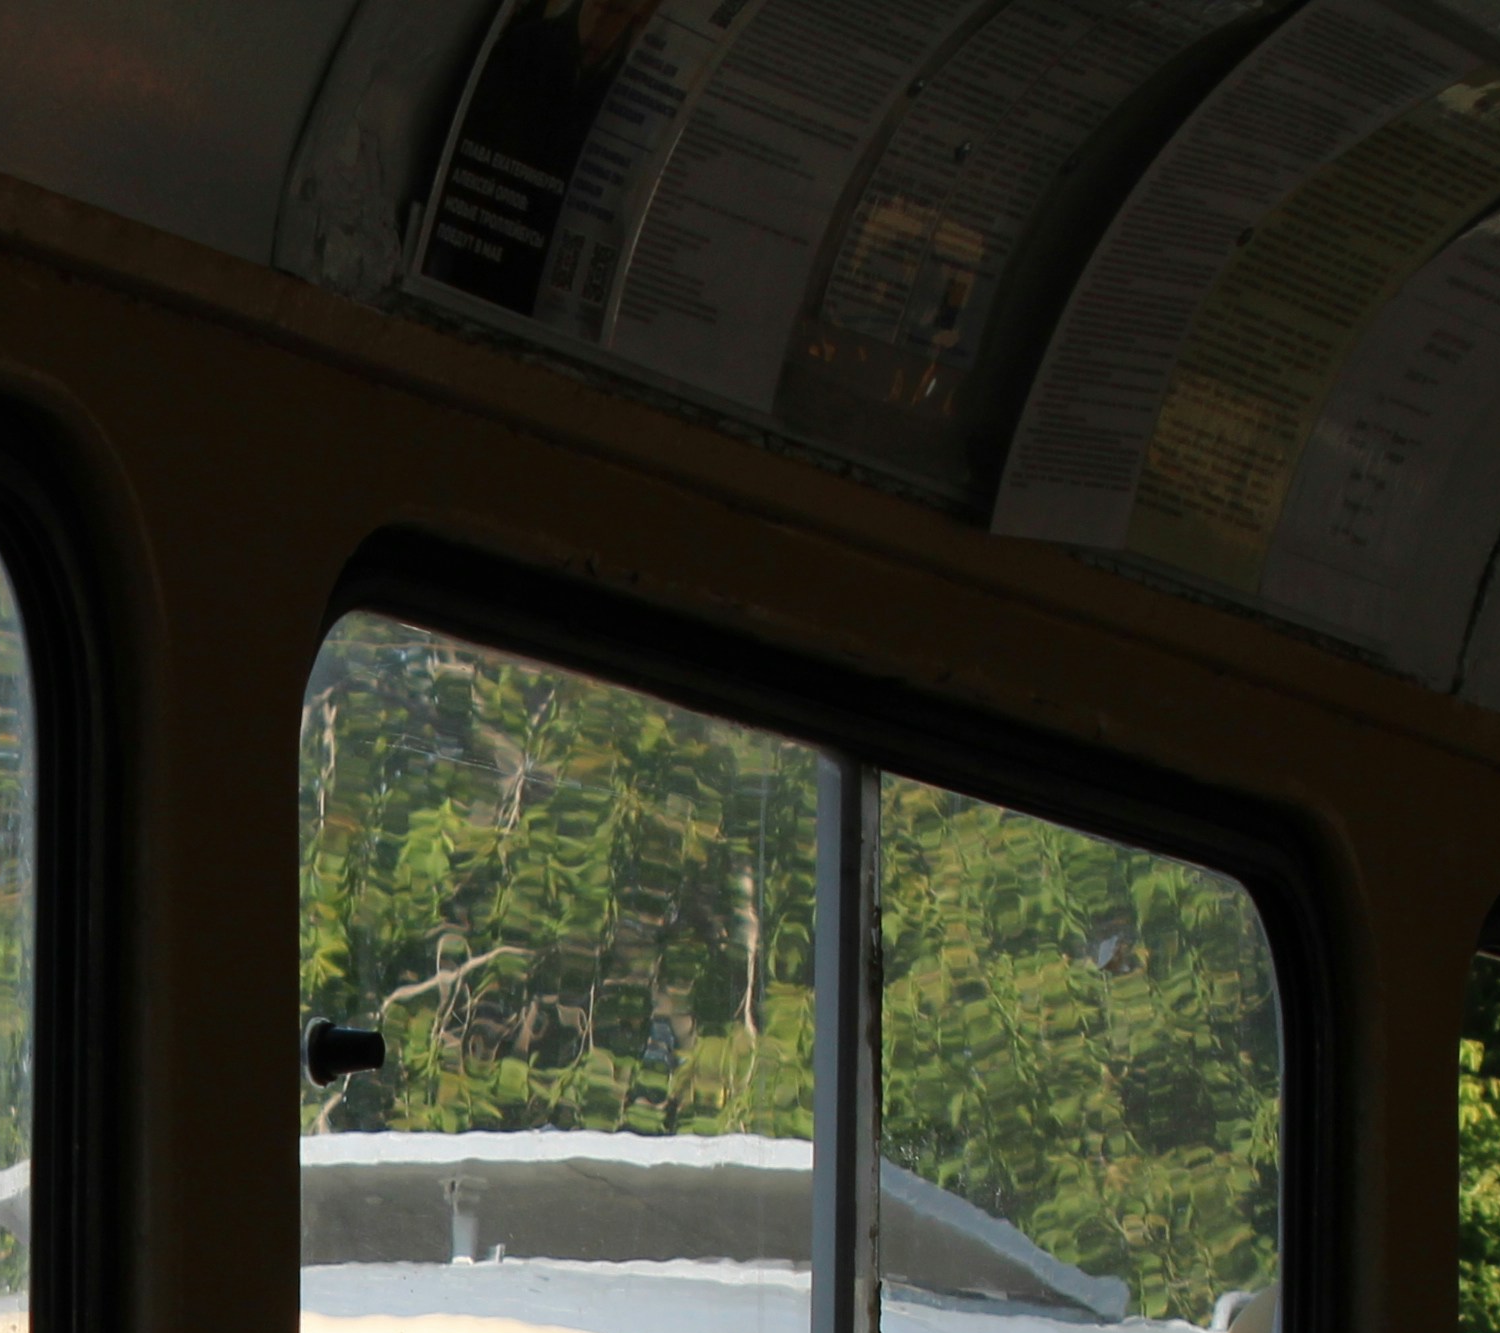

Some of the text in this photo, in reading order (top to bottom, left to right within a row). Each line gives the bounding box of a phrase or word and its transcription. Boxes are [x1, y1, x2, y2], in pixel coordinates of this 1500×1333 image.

[451, 167, 496, 197] АЛЕКСЕЙ
[460, 139, 493, 166] ГЛАВА
[491, 152, 565, 196] ЕКАТЕРИНБУРГА
[436, 221, 475, 250] ПОЕДУТ
[481, 240, 505, 263] МАЕ
[444, 195, 480, 222] НОВЫЕ
[479, 207, 546, 249] ТРОЛЛЕЙБУСЫ
